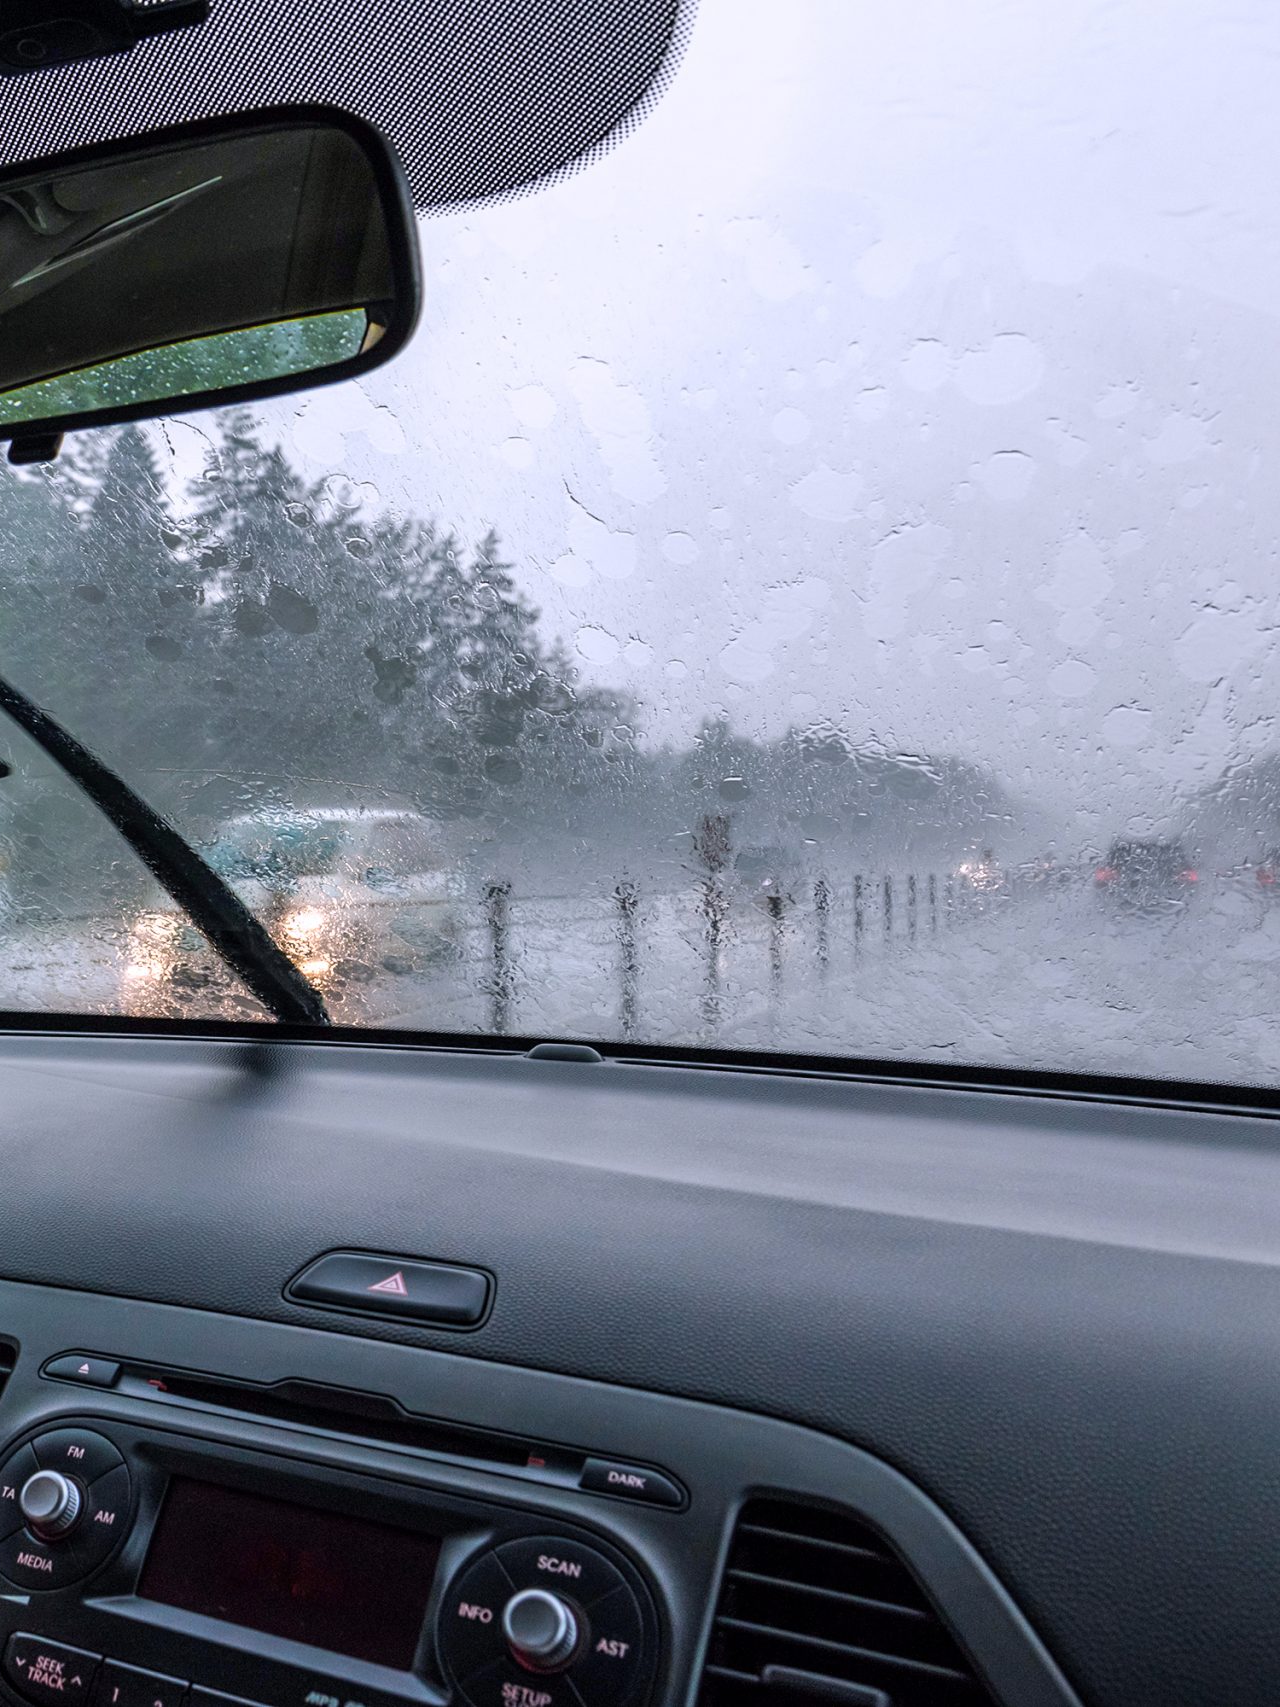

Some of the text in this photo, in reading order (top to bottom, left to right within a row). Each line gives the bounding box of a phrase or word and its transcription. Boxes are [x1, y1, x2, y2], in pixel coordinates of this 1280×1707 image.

[67, 1446, 85, 1459] FM
[608, 1471, 646, 1489] DARK
[1, 1486, 15, 1499] TA
[94, 1510, 115, 1525] AM
[17, 1552, 53, 1573] MEDIA
[537, 1555, 582, 1578] SCAN
[458, 1602, 493, 1624] INFO
[596, 1638, 629, 1659] AST
[35, 1656, 65, 1675] SEEK
[27, 1666, 66, 1691] TRACK
[112, 1687, 119, 1703] 1
[501, 1682, 552, 1707] SETUP
